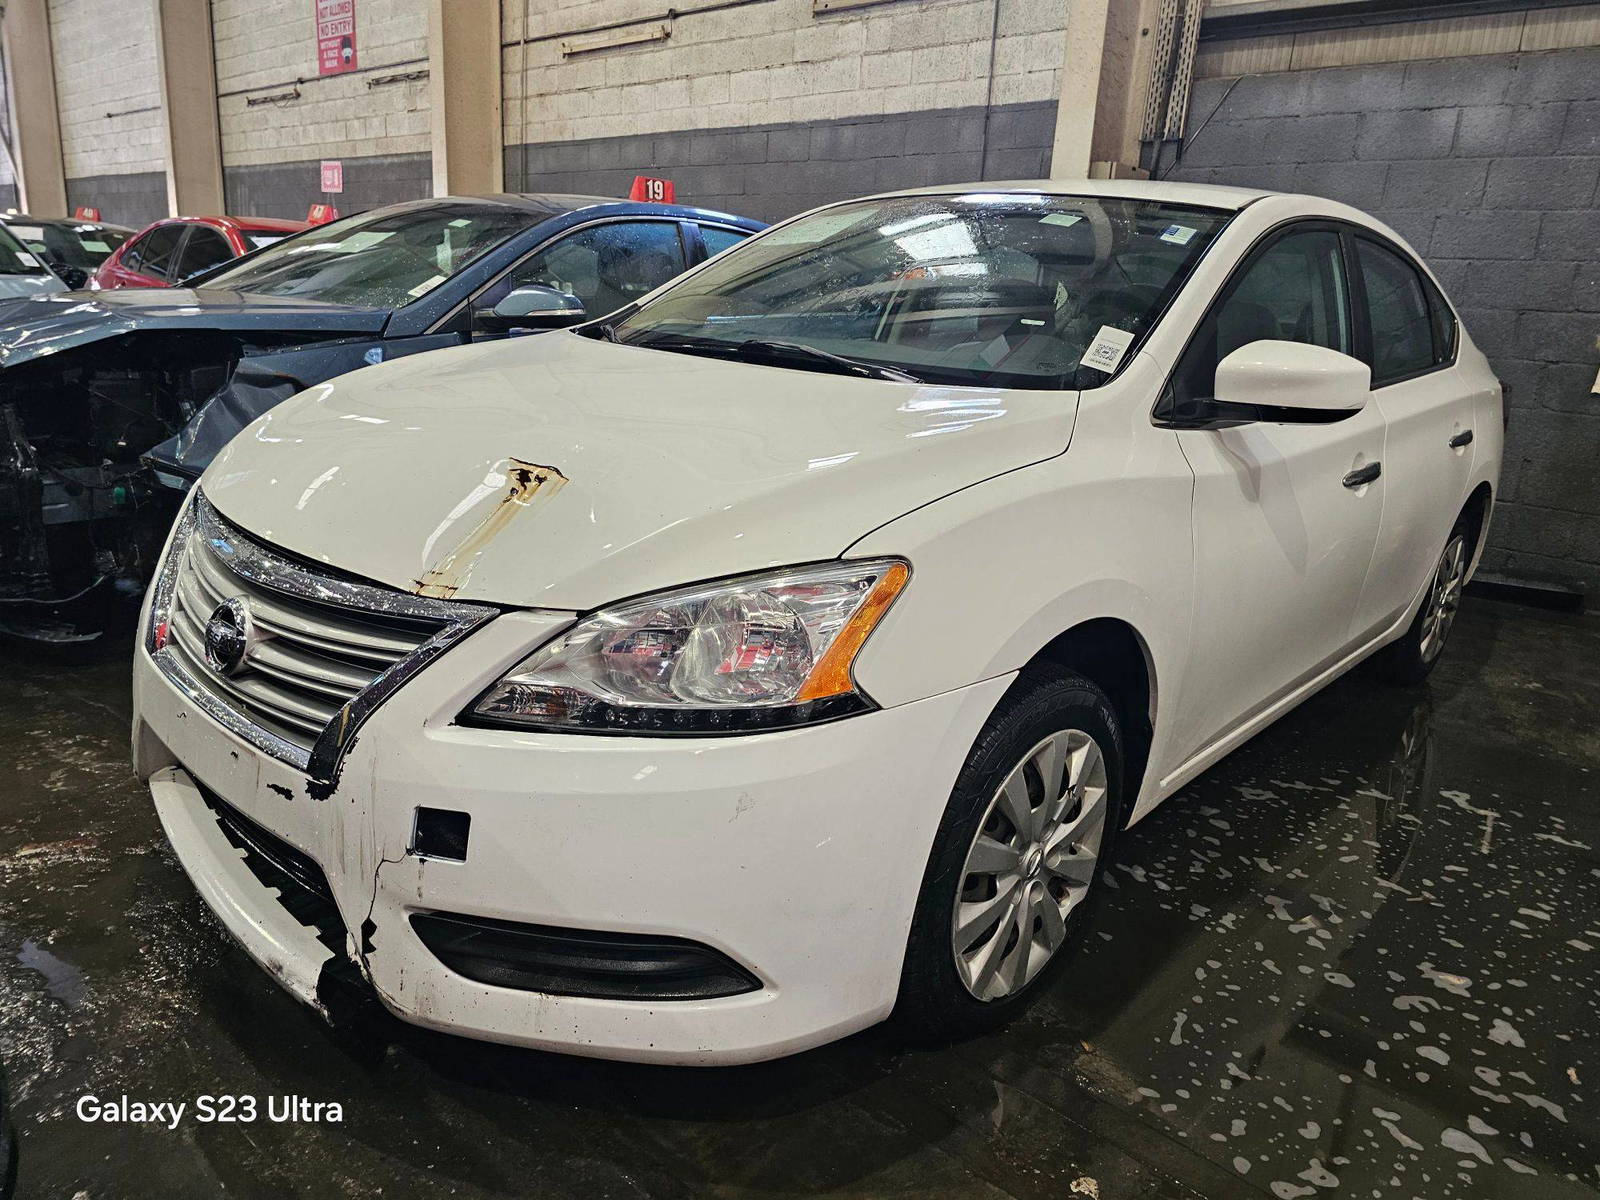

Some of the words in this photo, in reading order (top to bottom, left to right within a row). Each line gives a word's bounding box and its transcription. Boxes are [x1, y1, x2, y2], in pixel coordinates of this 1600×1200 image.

[329, 1, 351, 16] ALLOWED
[320, 23, 330, 37] NO
[331, 19, 352, 35] ENTRY
[647, 180, 664, 200] 19
